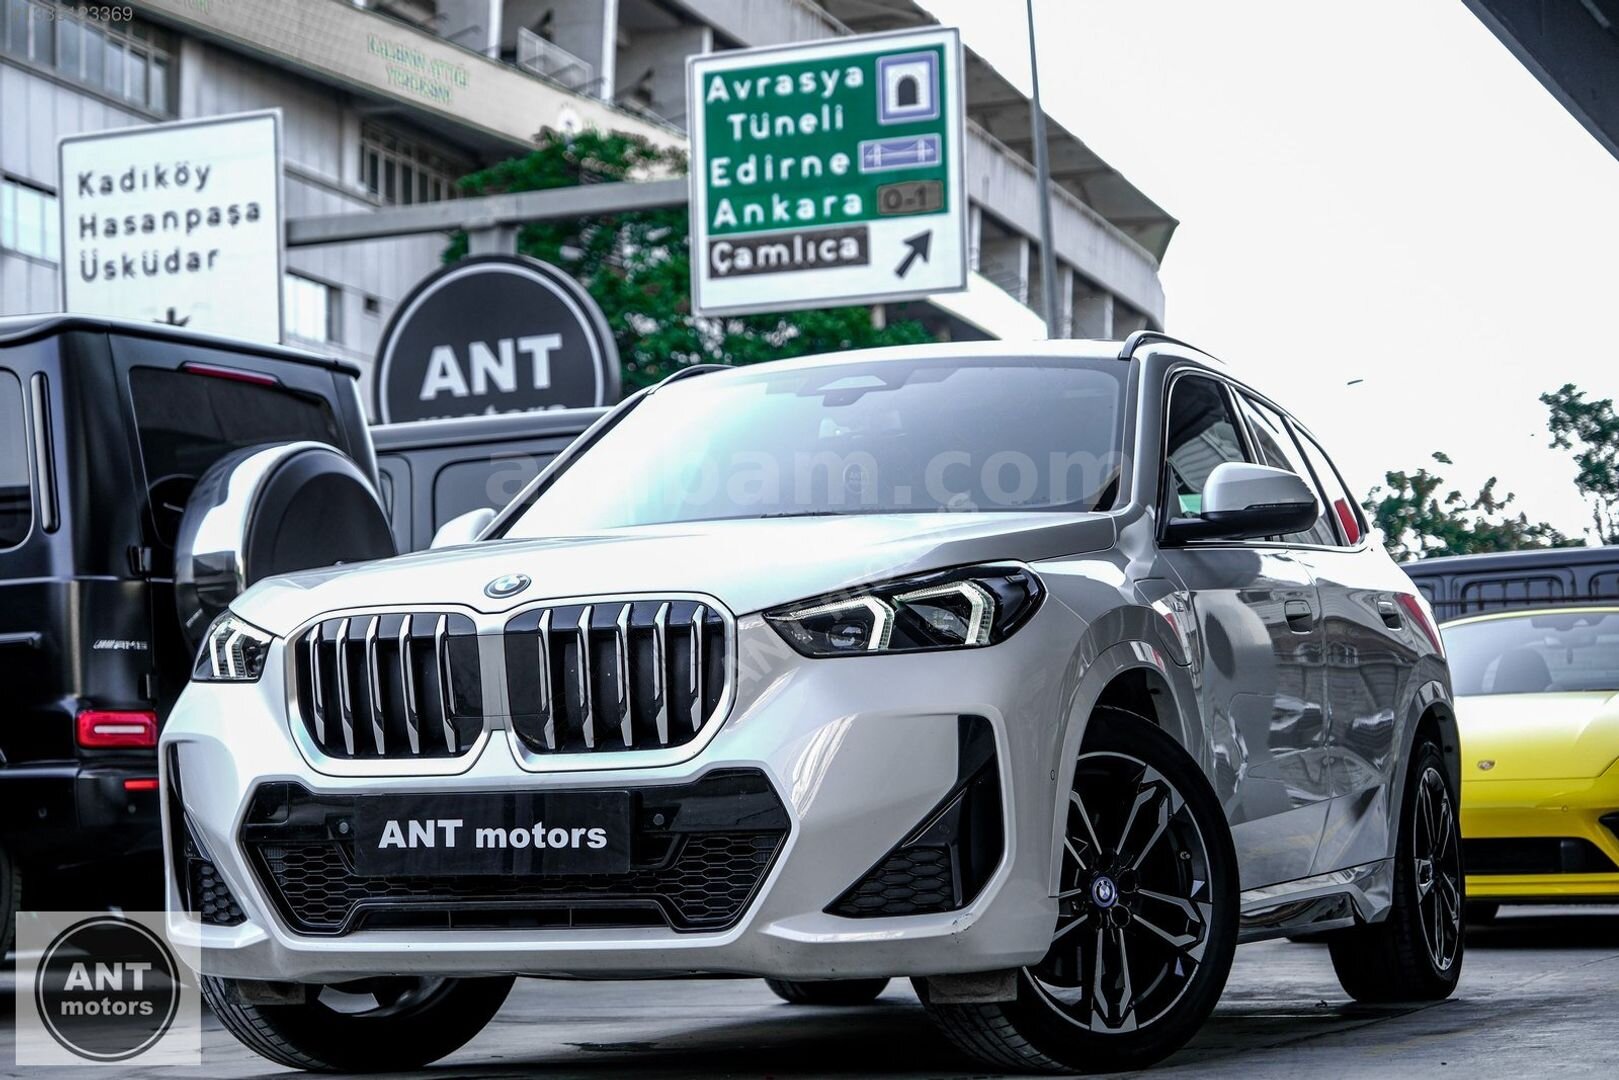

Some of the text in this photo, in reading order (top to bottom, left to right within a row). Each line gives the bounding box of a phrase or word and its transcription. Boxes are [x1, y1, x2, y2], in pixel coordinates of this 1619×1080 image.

[706, 66, 864, 104] Avrasya
[727, 103, 844, 142] Tüneli
[78, 161, 211, 198] Kadıköy
[710, 152, 850, 188] Edirne
[79, 201, 261, 240] Hasanpaşa
[713, 193, 863, 229] Ankara
[80, 246, 220, 283] Üsküdar
[711, 235, 860, 275] Çamlıca
[419, 333, 563, 401] ANT
[378, 819, 608, 849] ANT motors
